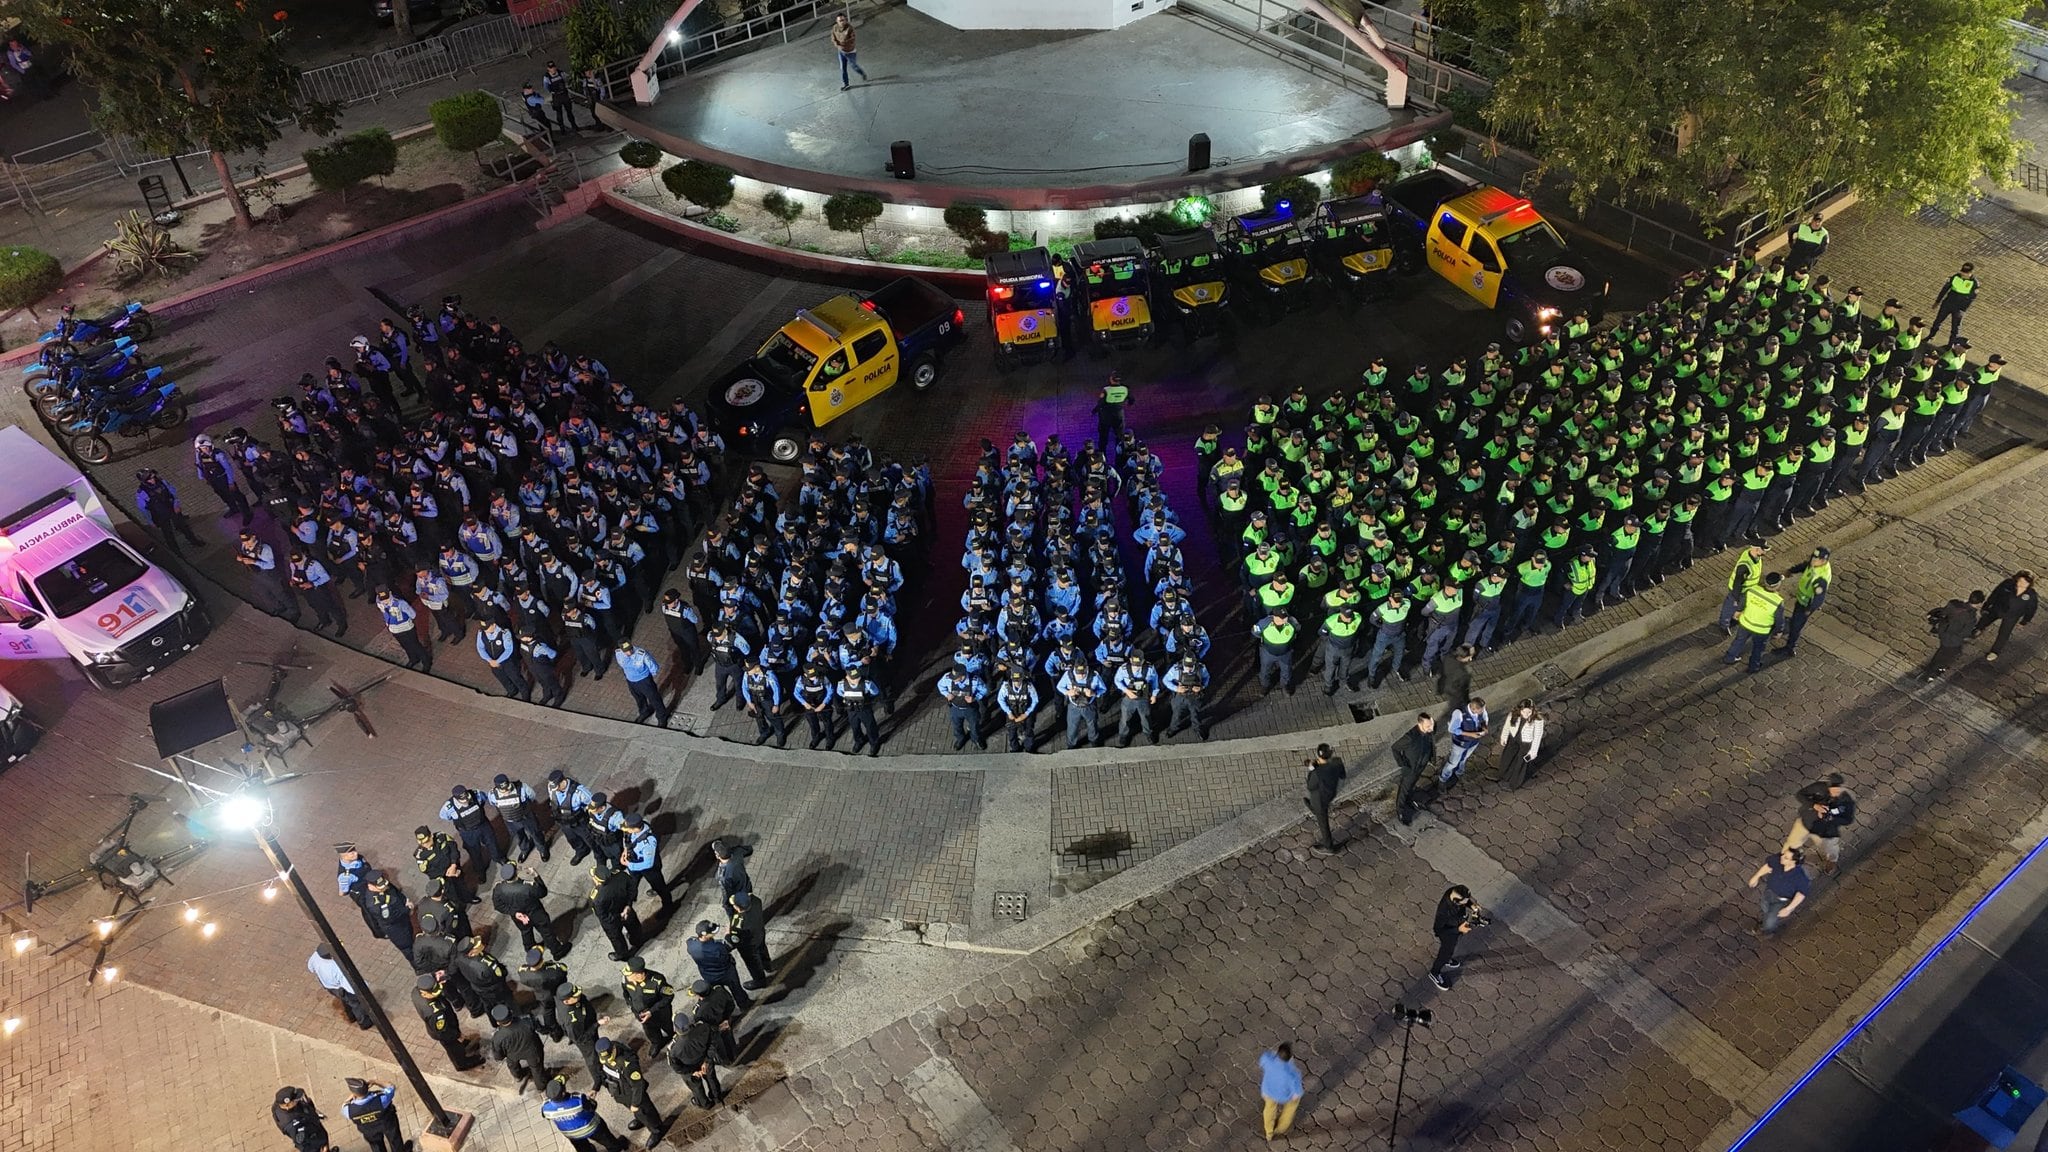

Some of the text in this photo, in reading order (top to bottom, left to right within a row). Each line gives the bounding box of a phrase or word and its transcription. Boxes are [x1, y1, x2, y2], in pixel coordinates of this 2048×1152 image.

[1340, 213, 1383, 225] POLICIA MUNICIPAL
[1268, 222, 1293, 233] MUNICIPAL
[1432, 247, 1456, 267] POLICIA
[938, 321, 951, 335] 09
[1112, 317, 1136, 327] POLICIA
[1016, 332, 1041, 342] POLICIA
[863, 363, 891, 384] POLICIA
[97, 590, 146, 632] 911
